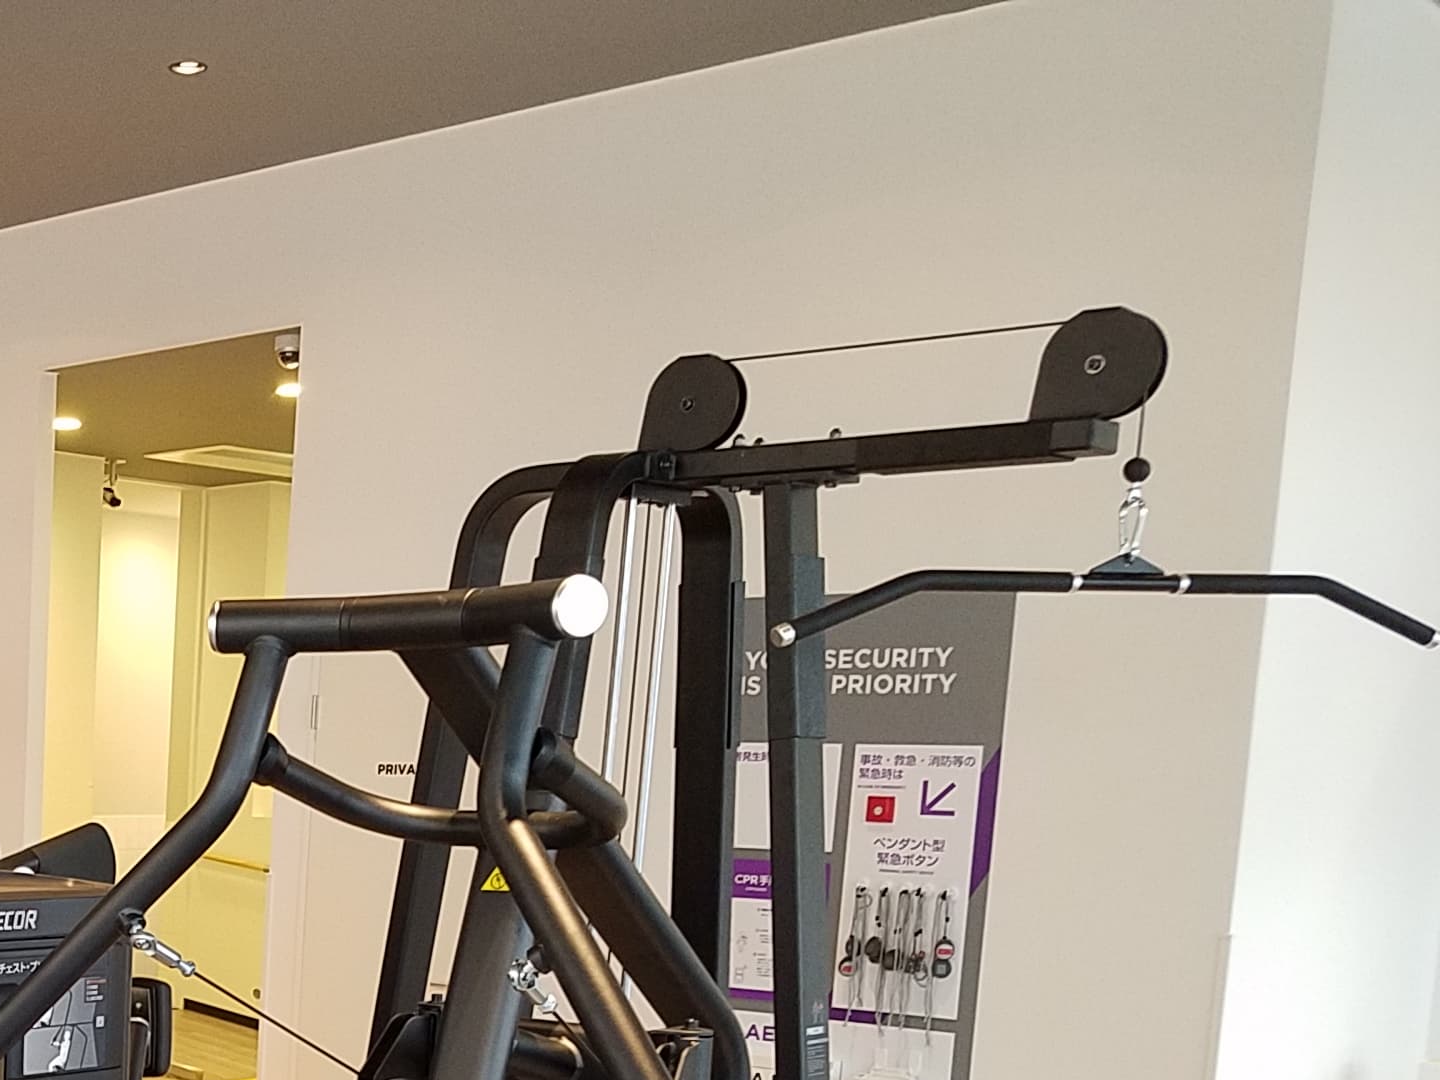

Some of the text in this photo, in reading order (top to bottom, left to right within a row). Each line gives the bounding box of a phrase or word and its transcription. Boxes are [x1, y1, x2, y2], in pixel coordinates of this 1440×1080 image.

[825, 647, 954, 669] SECURITY
[741, 673, 957, 695] IS PRIORITY
[873, 838, 946, 852] ペンダント型
